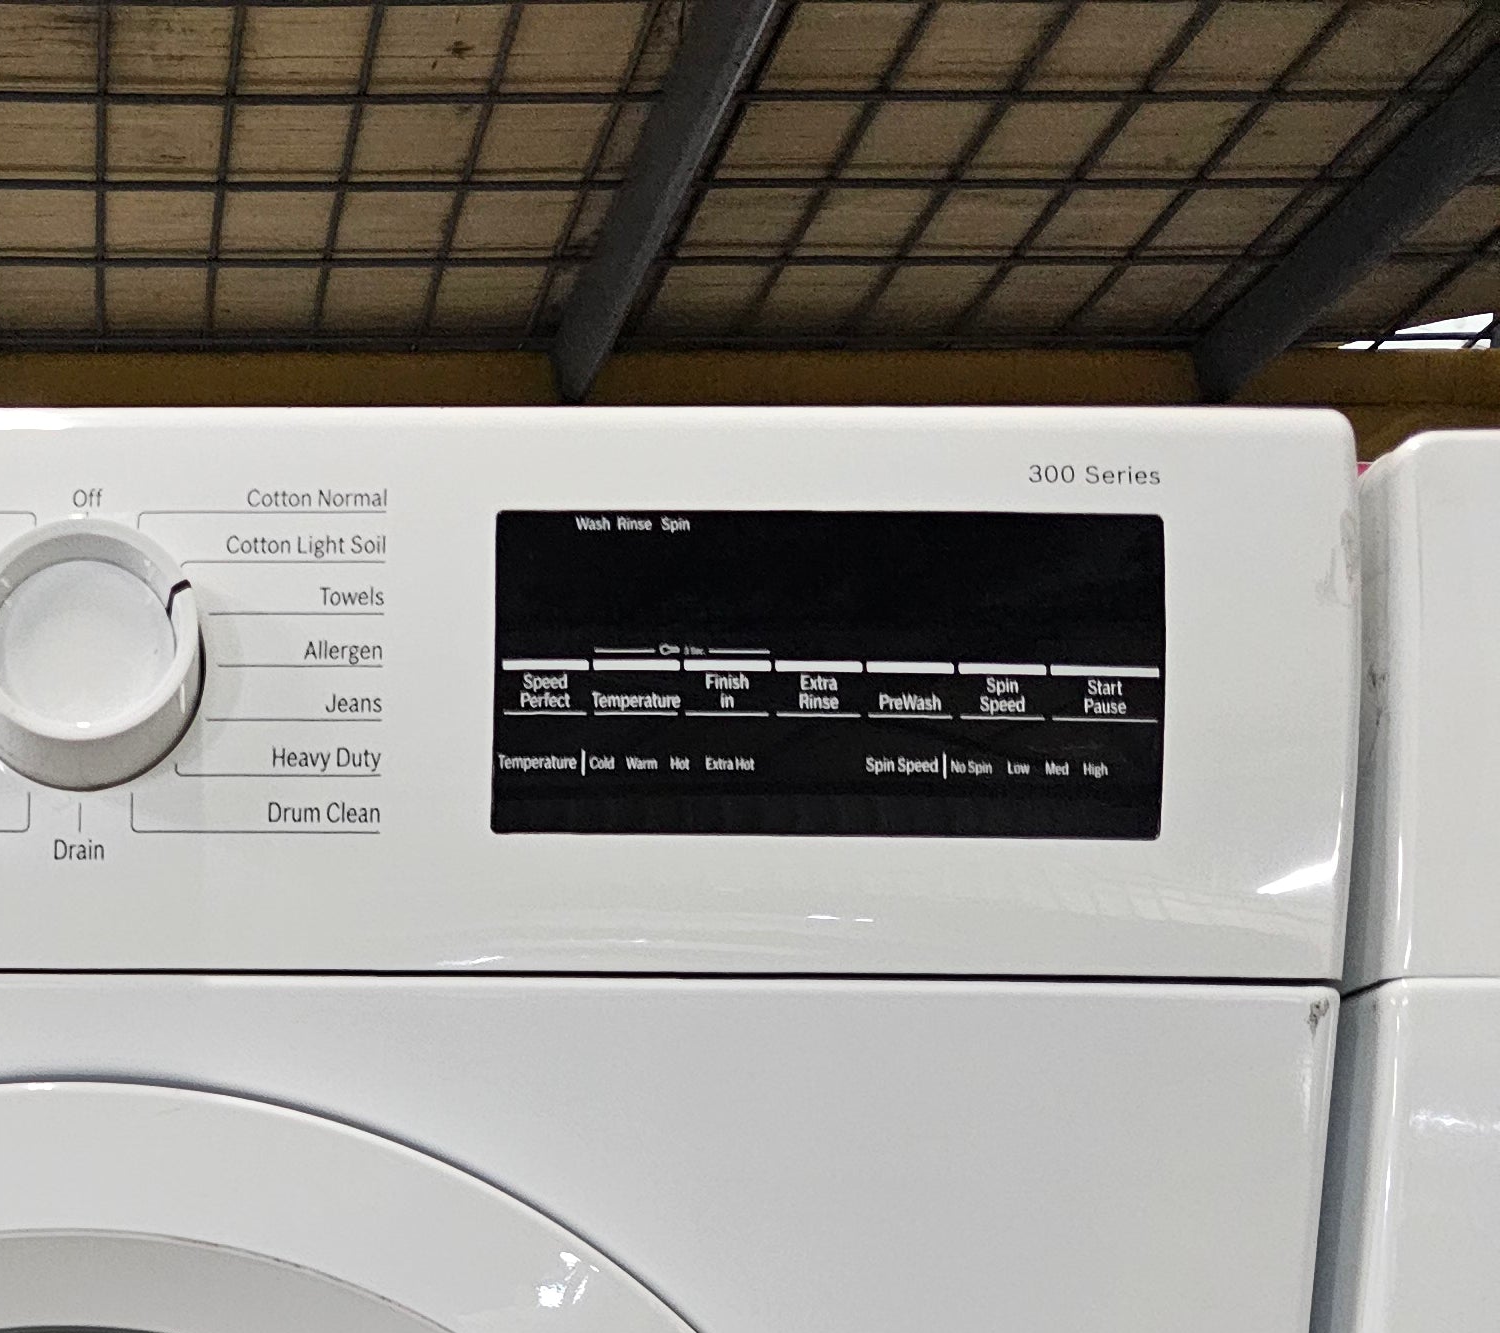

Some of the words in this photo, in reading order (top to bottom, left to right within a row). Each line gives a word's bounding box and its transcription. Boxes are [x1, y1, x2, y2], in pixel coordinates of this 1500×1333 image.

[1028, 464, 1075, 484] 300
[1085, 465, 1161, 485] Series
[72, 488, 103, 508] Off
[246, 488, 312, 508] Cotton
[317, 488, 388, 508] Normal
[575, 515, 611, 531] Wash
[617, 515, 653, 531] Rinse
[660, 515, 691, 534] Spin
[226, 535, 291, 555] Cotton
[297, 535, 346, 558] Light
[350, 535, 387, 556] Soil
[319, 585, 385, 607] Towels
[303, 640, 383, 665] Allergen
[522, 672, 568, 692] Speed
[705, 672, 749, 691] Finish
[800, 674, 838, 692] Extra
[986, 676, 1019, 697] Spin
[1087, 678, 1123, 697] Start
[325, 693, 383, 714] Jeans
[519, 690, 571, 710] Perfect
[592, 690, 681, 712] Temperature
[720, 691, 734, 710] in
[798, 692, 839, 710] Rinse
[878, 691, 943, 713] PreWash
[979, 695, 1026, 716] Speed
[1083, 697, 1127, 716] Pause
[272, 748, 331, 773] Heavy
[336, 748, 382, 773] Duty
[498, 754, 578, 773] Temperature
[589, 756, 615, 771] Cold
[626, 756, 659, 771] Warm
[670, 756, 690, 771] Hot
[705, 756, 734, 772] Extra
[735, 757, 755, 772] Hot
[866, 756, 896, 775] Spin
[898, 756, 939, 775] Speed
[951, 760, 966, 774] No
[967, 760, 993, 776] Spin
[1007, 760, 1031, 775] Low
[1045, 761, 1070, 776] Med
[1083, 762, 1109, 779] High
[268, 801, 321, 823] Drum
[327, 801, 381, 824] Clean
[54, 839, 105, 860] Drain
